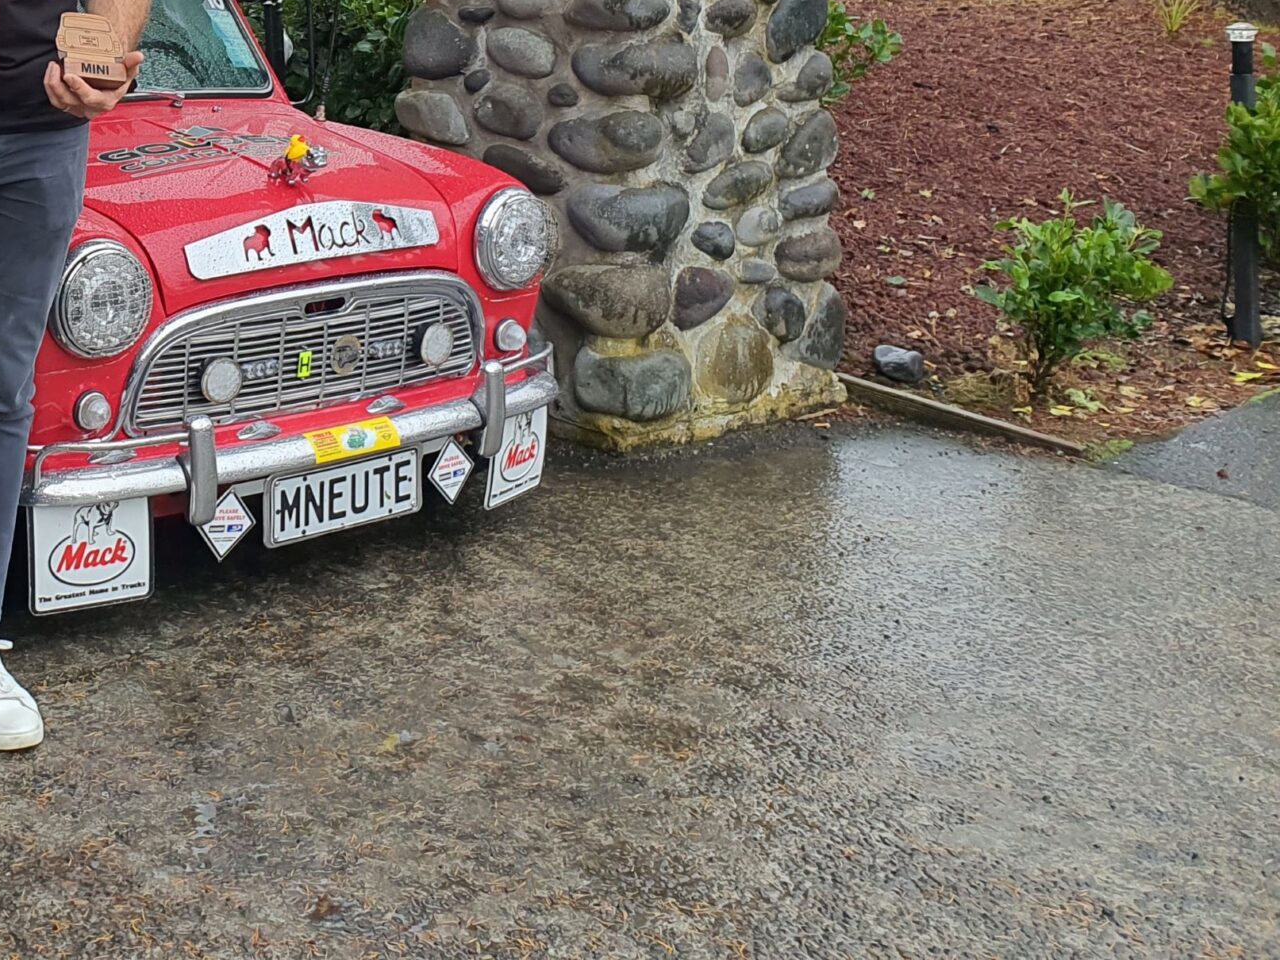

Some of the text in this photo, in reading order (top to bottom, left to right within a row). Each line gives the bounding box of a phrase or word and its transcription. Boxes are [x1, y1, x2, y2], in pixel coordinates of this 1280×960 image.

[81, 62, 109, 75] MINI
[286, 210, 371, 255] Mack
[503, 438, 535, 472] Mack
[280, 459, 411, 532] MNEUTE
[57, 538, 128, 573] Mack
[38, 596, 52, 604] The
[54, 591, 86, 601] Greatest
[121, 581, 146, 590] Trucks
